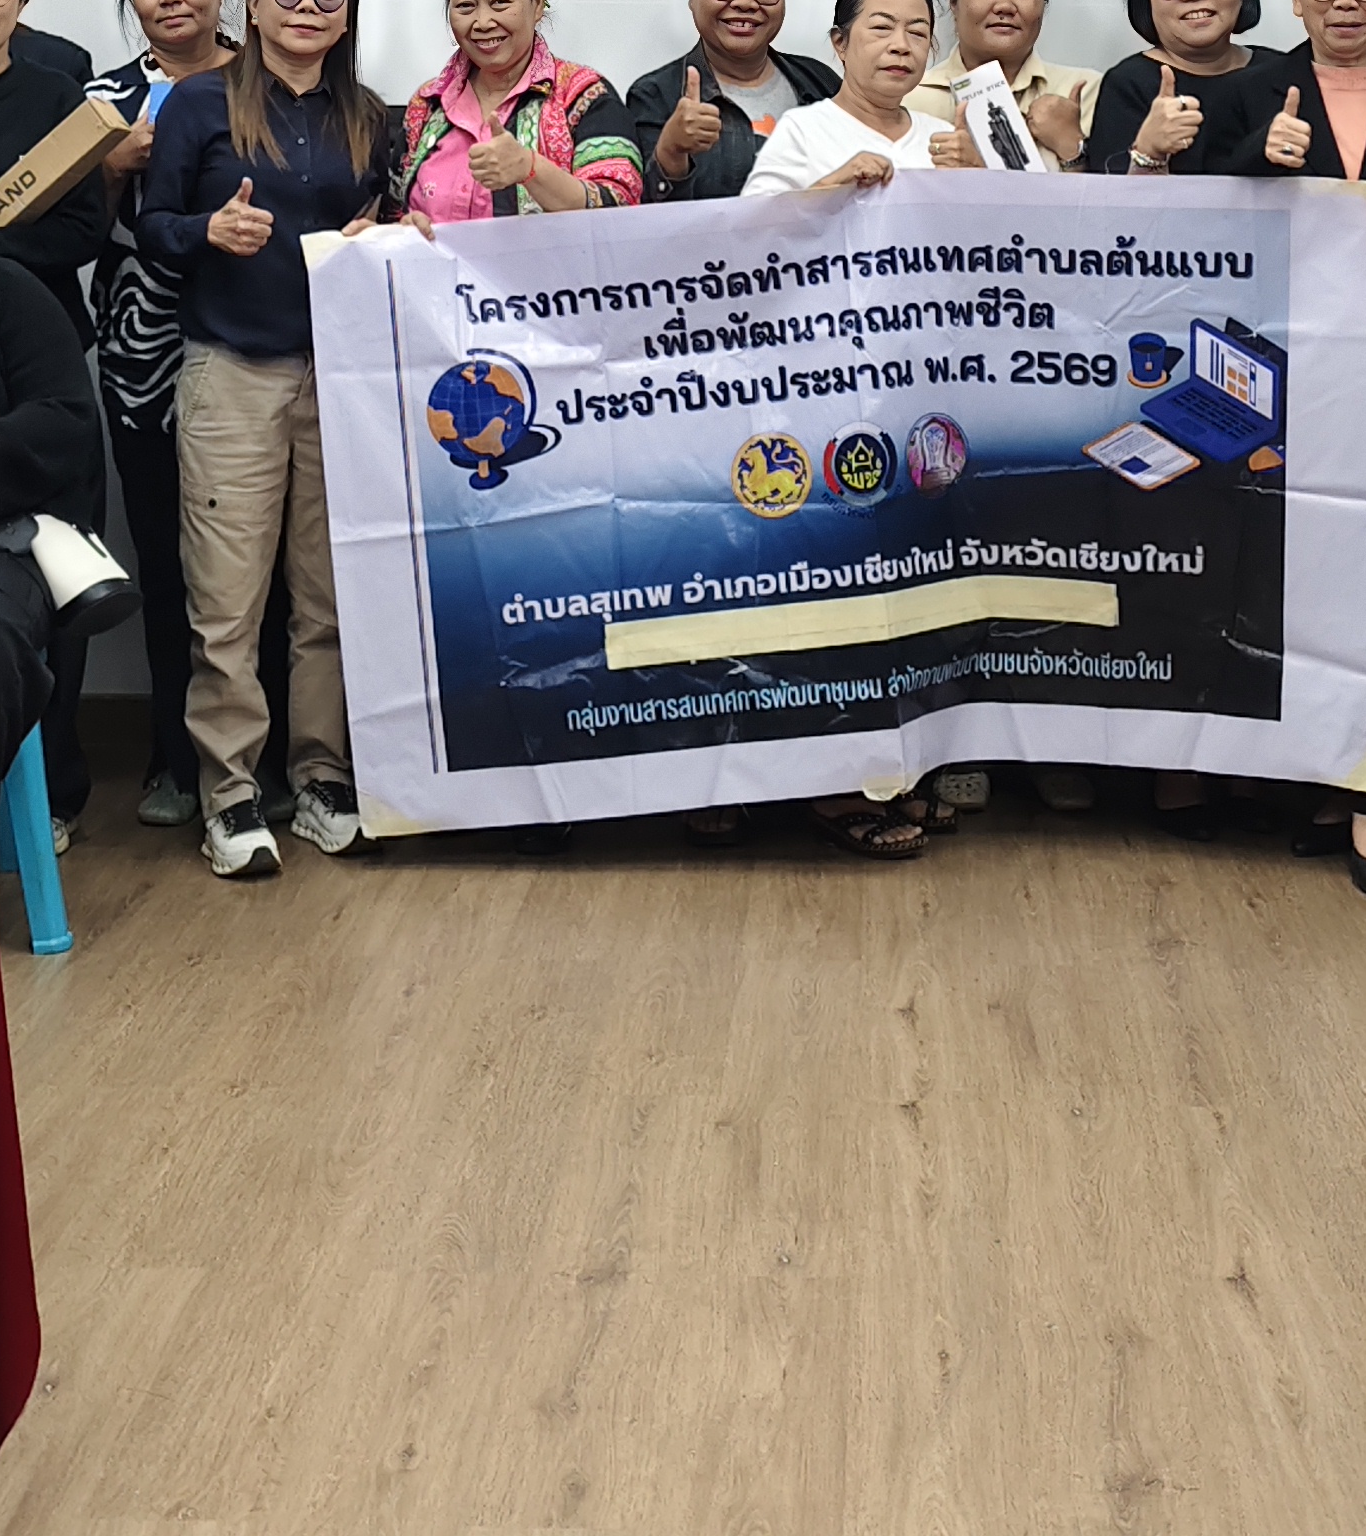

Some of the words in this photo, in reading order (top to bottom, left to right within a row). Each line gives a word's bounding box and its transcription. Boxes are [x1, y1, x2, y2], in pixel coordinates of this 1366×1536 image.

[456, 234, 1254, 324] โครงการการจัดทำสารสนเทศตำบลต้นแบบ
[644, 286, 1056, 360] เพื่อพัฒนาคุณภาพชีวิต
[556, 354, 914, 425] ประจำปีงบประมาณ
[925, 353, 998, 384] พ.ศ.
[1010, 350, 1117, 387] 2569
[502, 583, 672, 625] ตำบลสุเทพ
[683, 539, 955, 605] อำเภอเมืองเชียงใหม่
[960, 538, 1204, 575] จังหวัดเชียงใหม่
[567, 678, 884, 736] กลุ่มงานสารสนเทศการพัฒนาชุมชน
